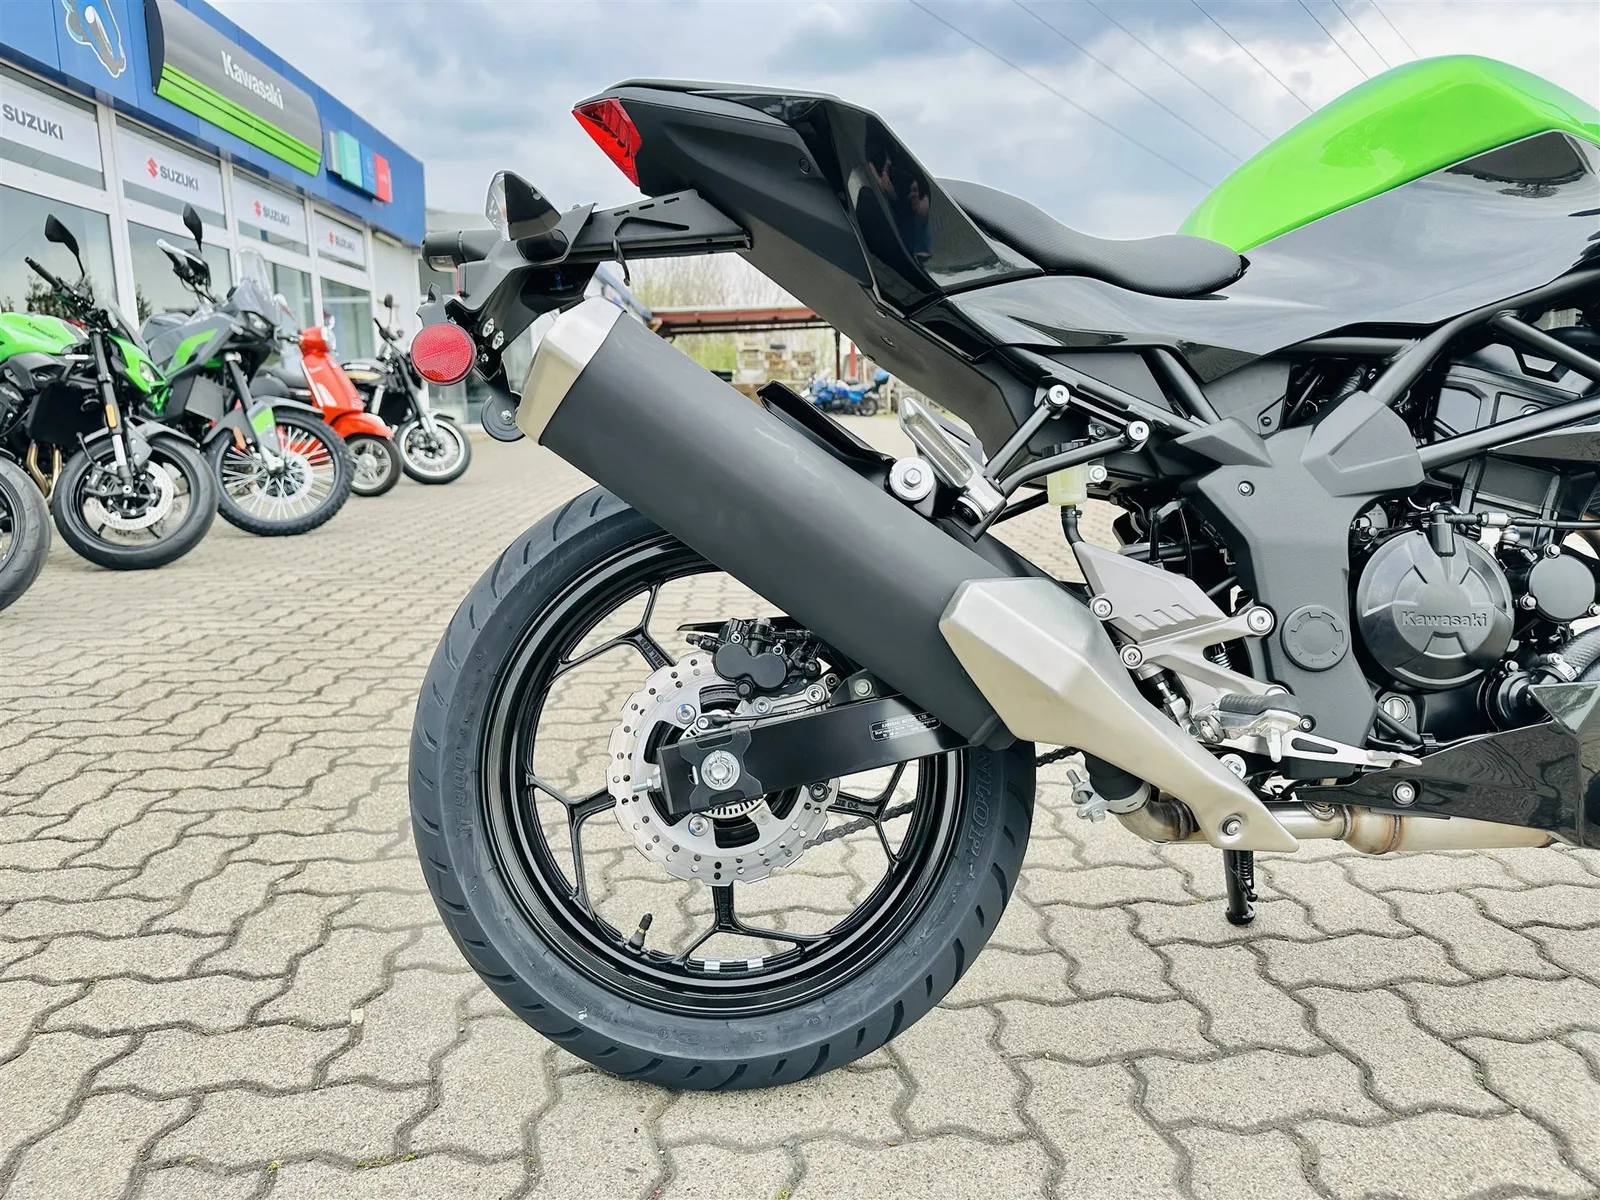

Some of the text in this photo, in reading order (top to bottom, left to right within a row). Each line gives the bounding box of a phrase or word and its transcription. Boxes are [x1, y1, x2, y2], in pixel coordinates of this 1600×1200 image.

[220, 49, 284, 110] Kawasaki
[2, 104, 64, 141] SUZUKI
[159, 165, 200, 191] SUZUKI
[262, 205, 291, 226] SUZUKI
[1402, 610, 1488, 628] Kawasaki
